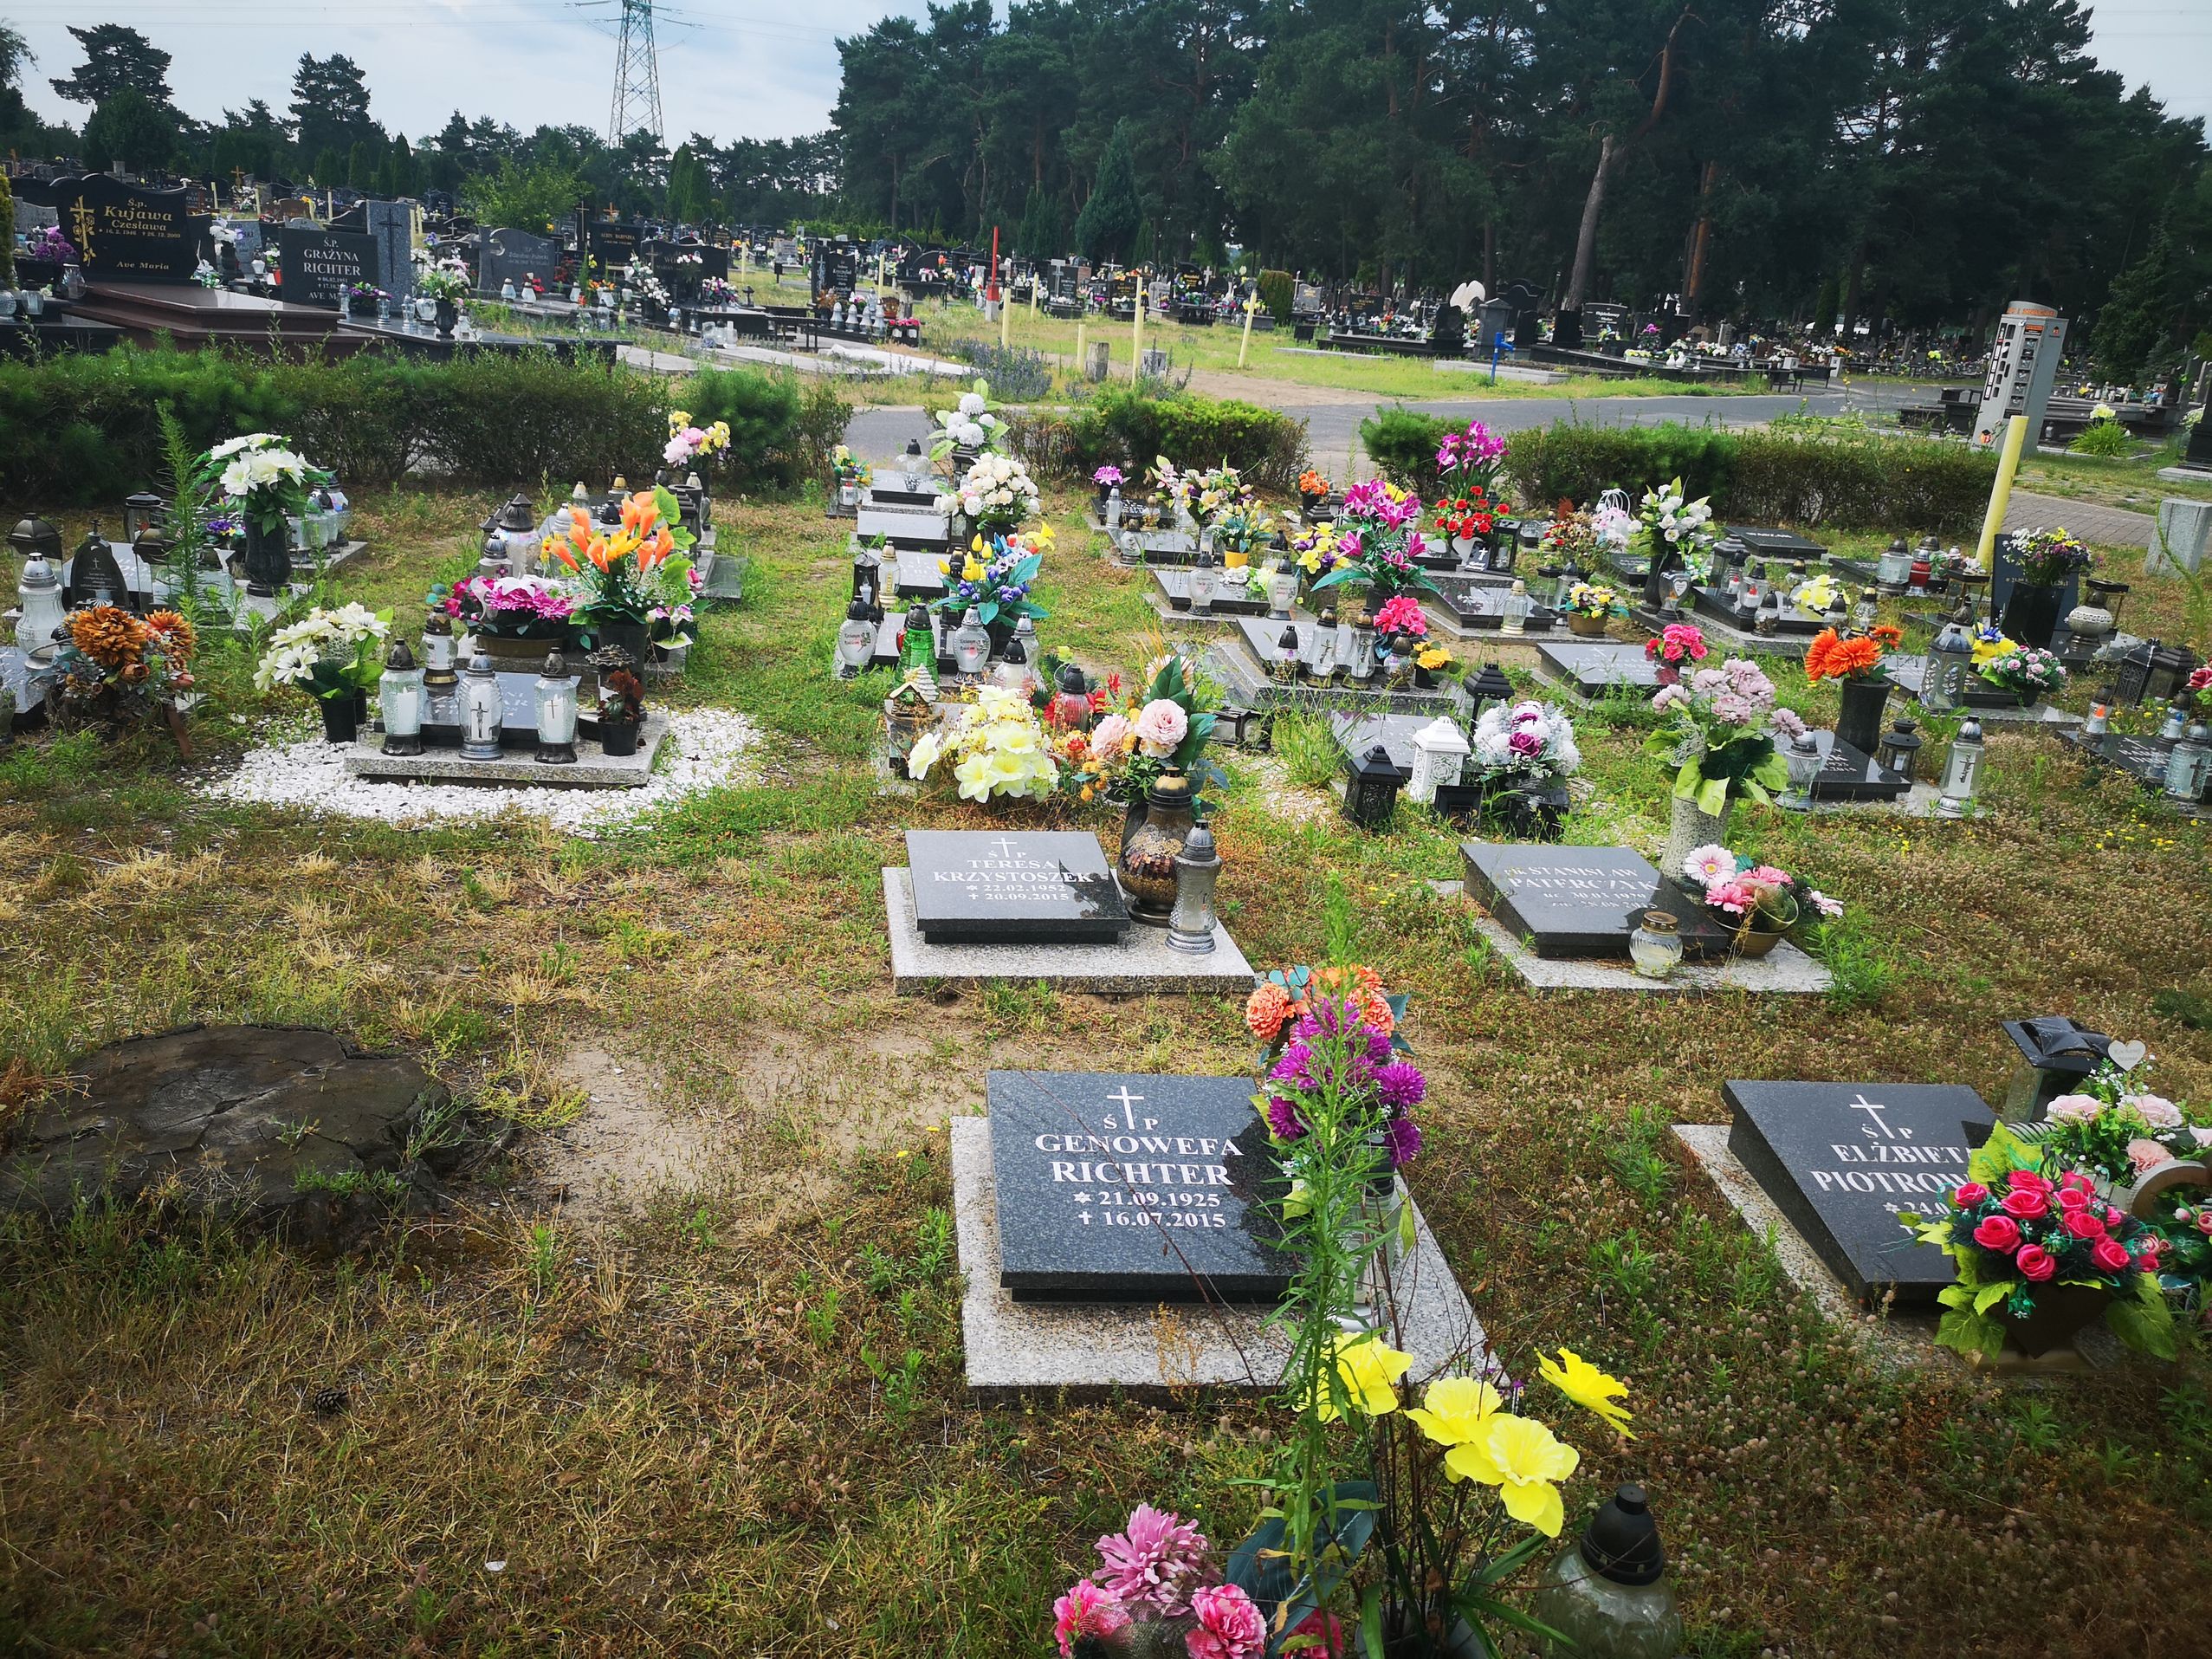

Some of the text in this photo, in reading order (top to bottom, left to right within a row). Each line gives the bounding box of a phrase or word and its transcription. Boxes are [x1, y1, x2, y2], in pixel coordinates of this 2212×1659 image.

[104, 205, 172, 222] Kujawa
[111, 219, 167, 231] Czesława
[303, 249, 359, 262] GRAŻYNA
[139, 262, 170, 270] Maria
[303, 262, 361, 276] RICHTER
[308, 291, 325, 300] AVE
[967, 859, 1057, 869] TERESA
[933, 872, 1095, 883] KRZYSTOSZEK
[1143, 1118, 1159, 1131] P
[1898, 1127, 1913, 1139] P
[1035, 1133, 1245, 1157] GENOWEFA
[1049, 1161, 1235, 1186] RICHTER
[1809, 1170, 1971, 1193] PIOTROW
[1098, 1191, 1221, 1208] 21.09.1925
[1103, 1211, 1226, 1228] 16.07.2015
